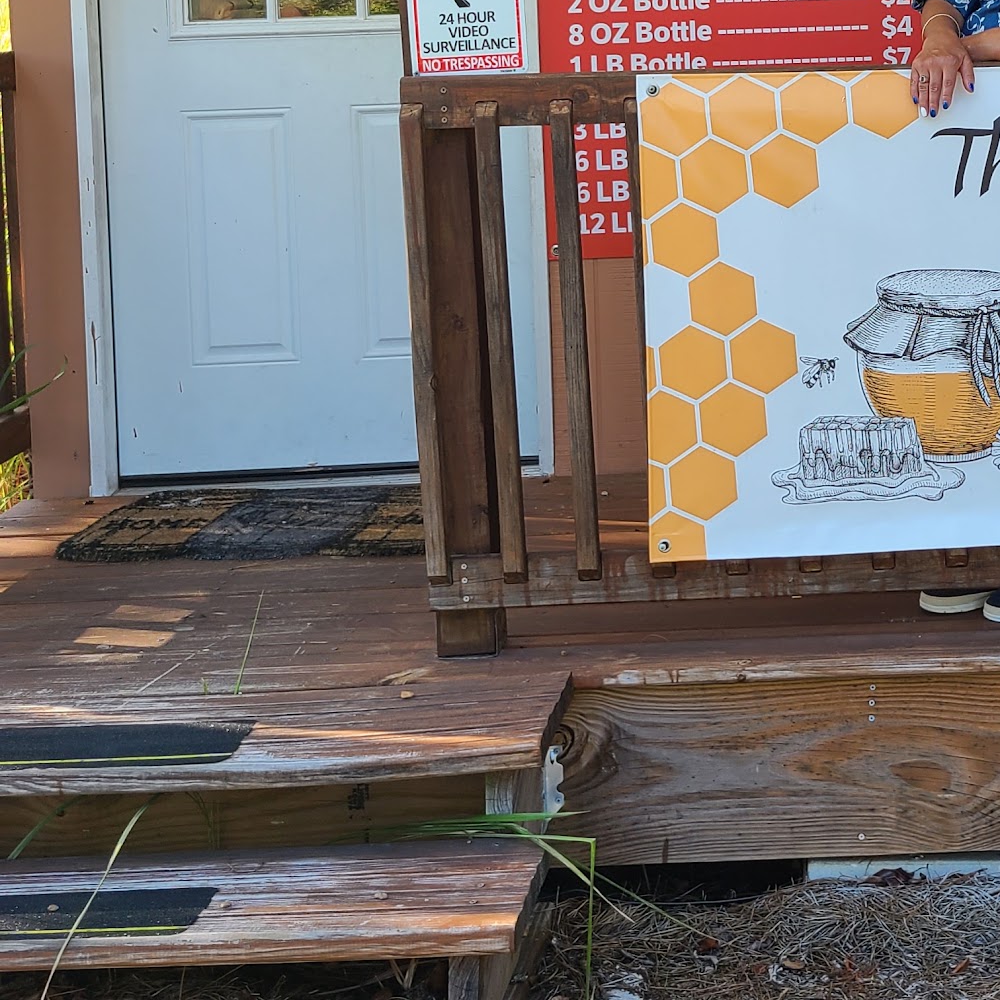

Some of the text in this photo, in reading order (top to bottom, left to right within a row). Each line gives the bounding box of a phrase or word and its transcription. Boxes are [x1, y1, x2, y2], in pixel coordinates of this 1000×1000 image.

[438, 11, 496, 25] 24 HOUR
[448, 25, 489, 38] VIDEO
[568, 14, 913, 45] 8 OZ Bottle $4
[423, 37, 516, 54] SURVEILLANCE
[422, 54, 520, 72] NO TRESPASSING
[569, 55, 581, 73] 1
[630, 52, 707, 72] Bottle
[882, 46, 912, 65] $7
[593, 122, 627, 139] LB
[575, 149, 629, 172] 6 LB
[577, 180, 630, 204] 6 LB
[579, 212, 606, 235] 12
